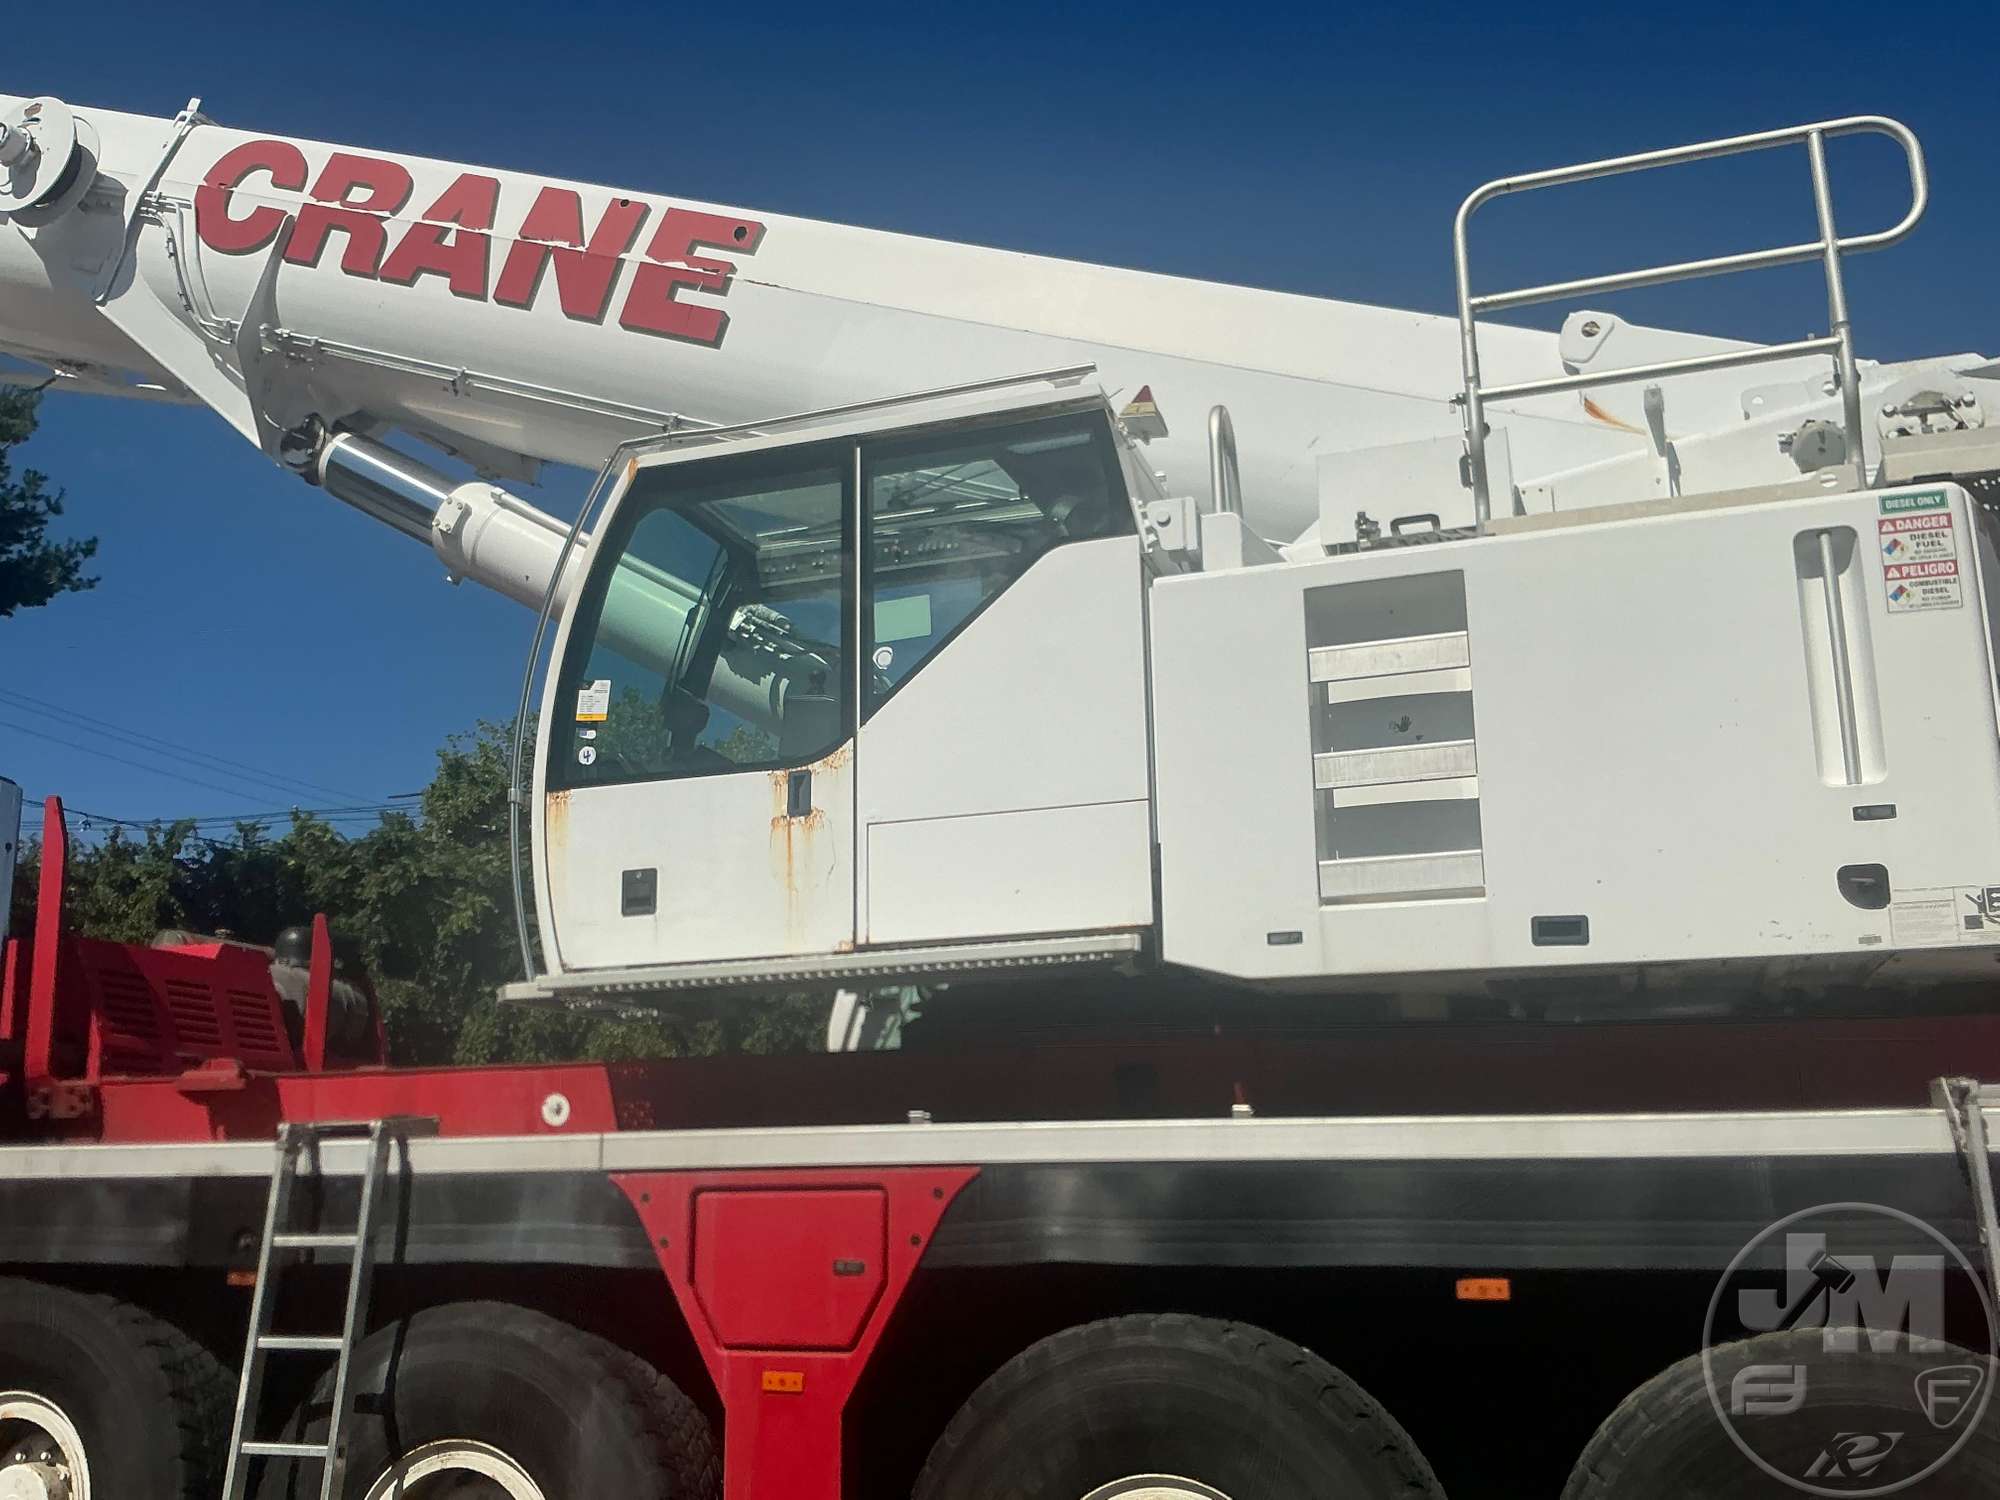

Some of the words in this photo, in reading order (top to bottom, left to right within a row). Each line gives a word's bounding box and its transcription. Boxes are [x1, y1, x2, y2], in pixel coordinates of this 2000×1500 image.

[195, 139, 768, 350] CRANE
[1886, 498, 1916, 509] DIESEL
[1918, 495, 1941, 506] ONLY
[1895, 515, 1948, 530] DANGER
[1910, 532, 1948, 541] DIESEL
[1915, 540, 1944, 548] FUEL
[1901, 562, 1955, 577] PELIGRO
[1922, 587, 1950, 595] DIESEL
[583, 750, 592, 763] 4
